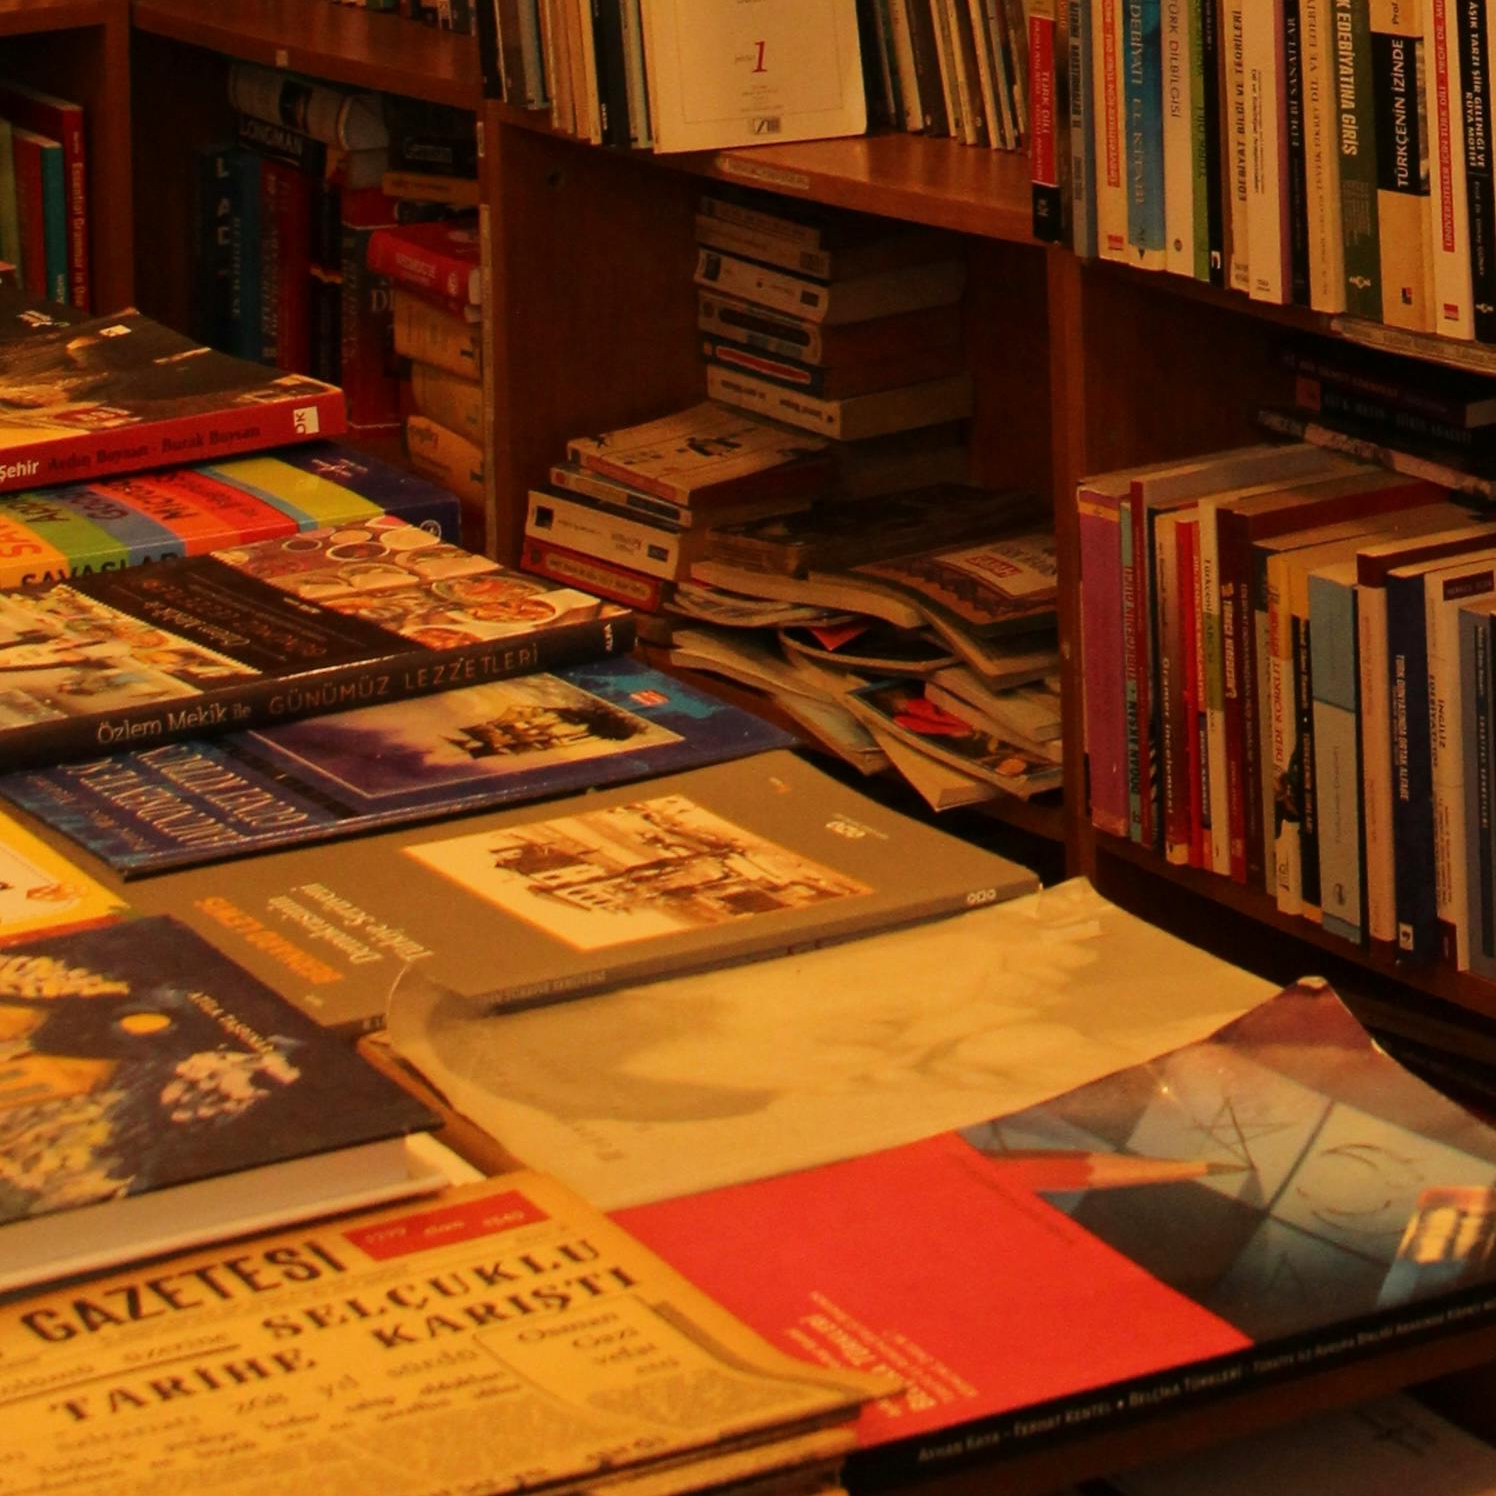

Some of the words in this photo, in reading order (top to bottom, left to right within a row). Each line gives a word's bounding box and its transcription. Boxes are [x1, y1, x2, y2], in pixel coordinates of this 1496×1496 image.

[753, 41, 767, 73] 1
[1336, 12, 1358, 108] EDEBİYATINA
[1339, 113, 1362, 155] GİRİŞ
[97, 715, 163, 745] Özlem
[167, 704, 226, 735] Mekik
[269, 674, 390, 716] GÜNÜMÜZ
[404, 643, 539, 689] LEZZETLERİ
[260, 1237, 602, 1341] SELÇUKLU
[370, 1265, 639, 1352] KARIŞTI
